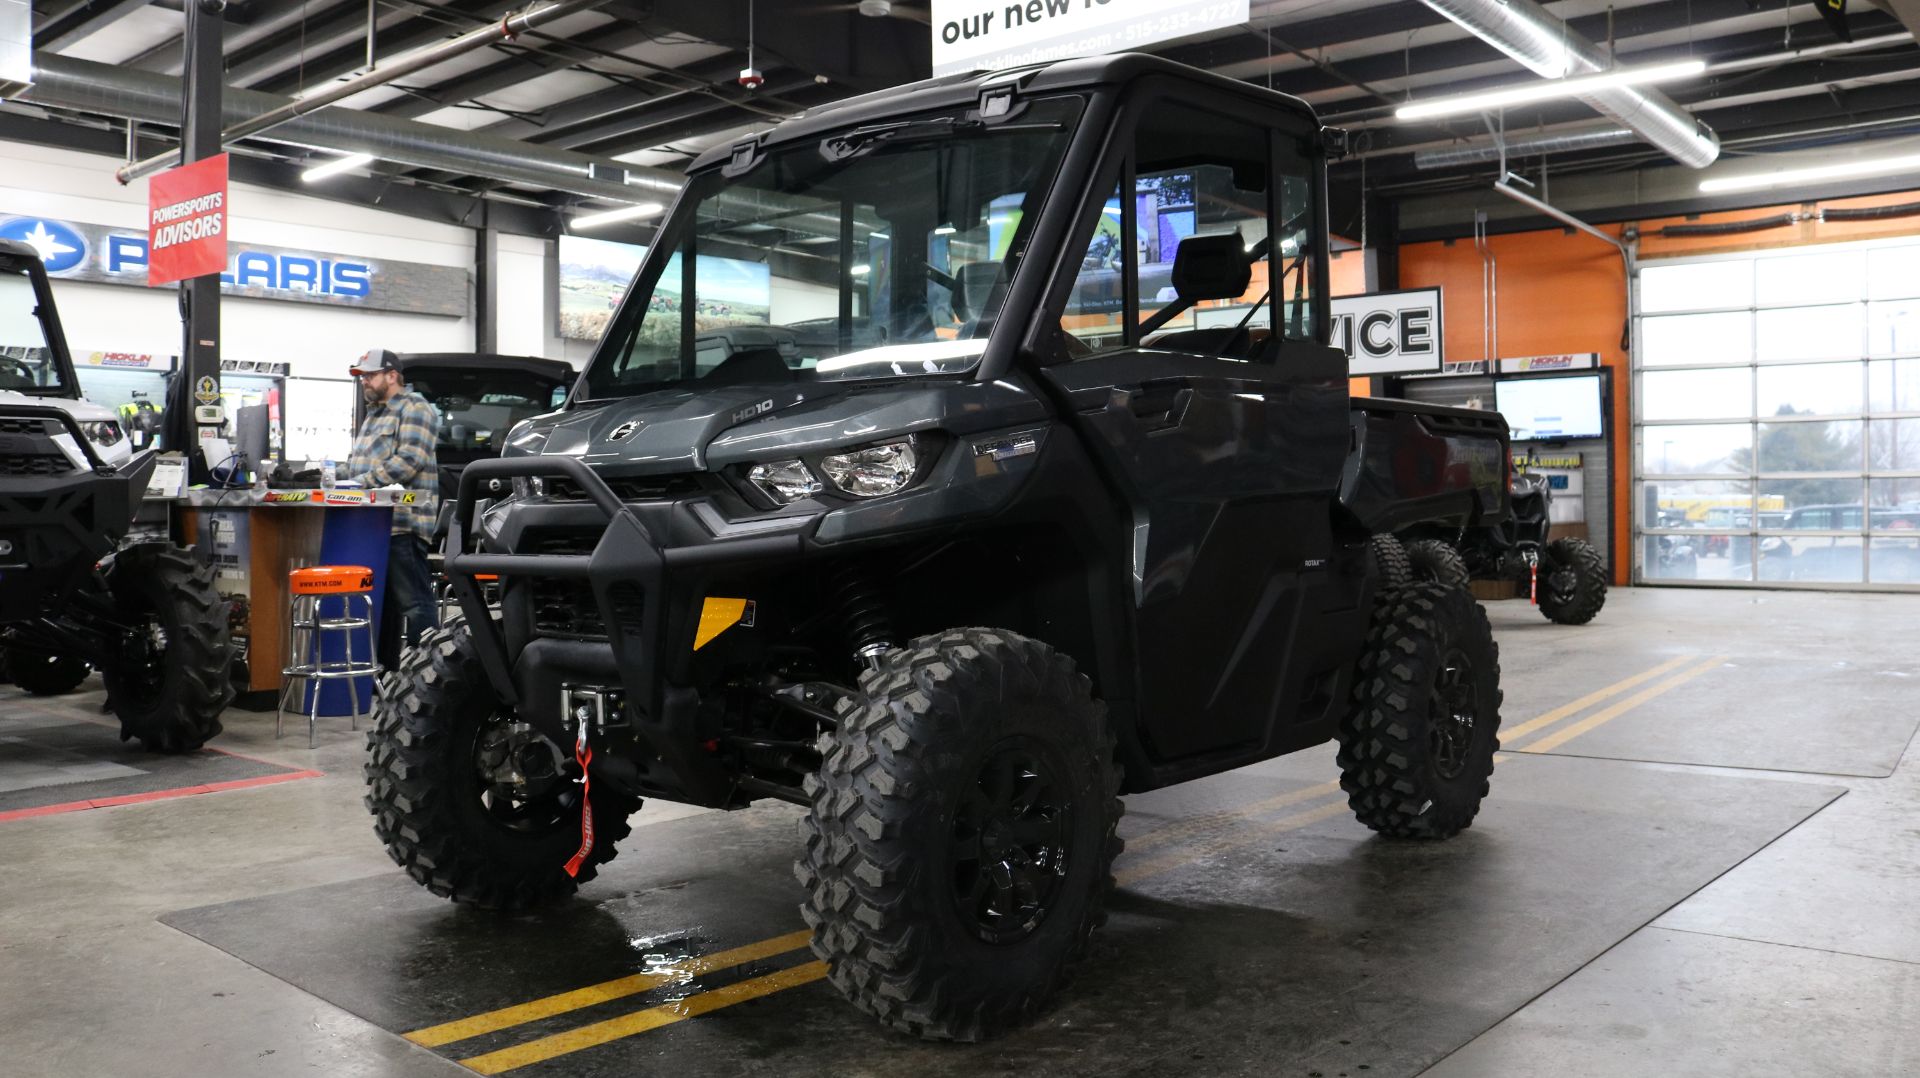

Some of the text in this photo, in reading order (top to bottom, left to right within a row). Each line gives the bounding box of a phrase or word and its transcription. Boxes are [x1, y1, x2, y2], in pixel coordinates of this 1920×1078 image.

[942, 0, 1070, 44] our new
[1126, 1, 1239, 41] 515-233-4727
[152, 191, 223, 226] POWERSPORTS
[152, 212, 223, 251] ADVISORS
[107, 235, 373, 298] PARIS
[103, 352, 152, 363] HICKLIN
[732, 398, 774, 424] HD10
